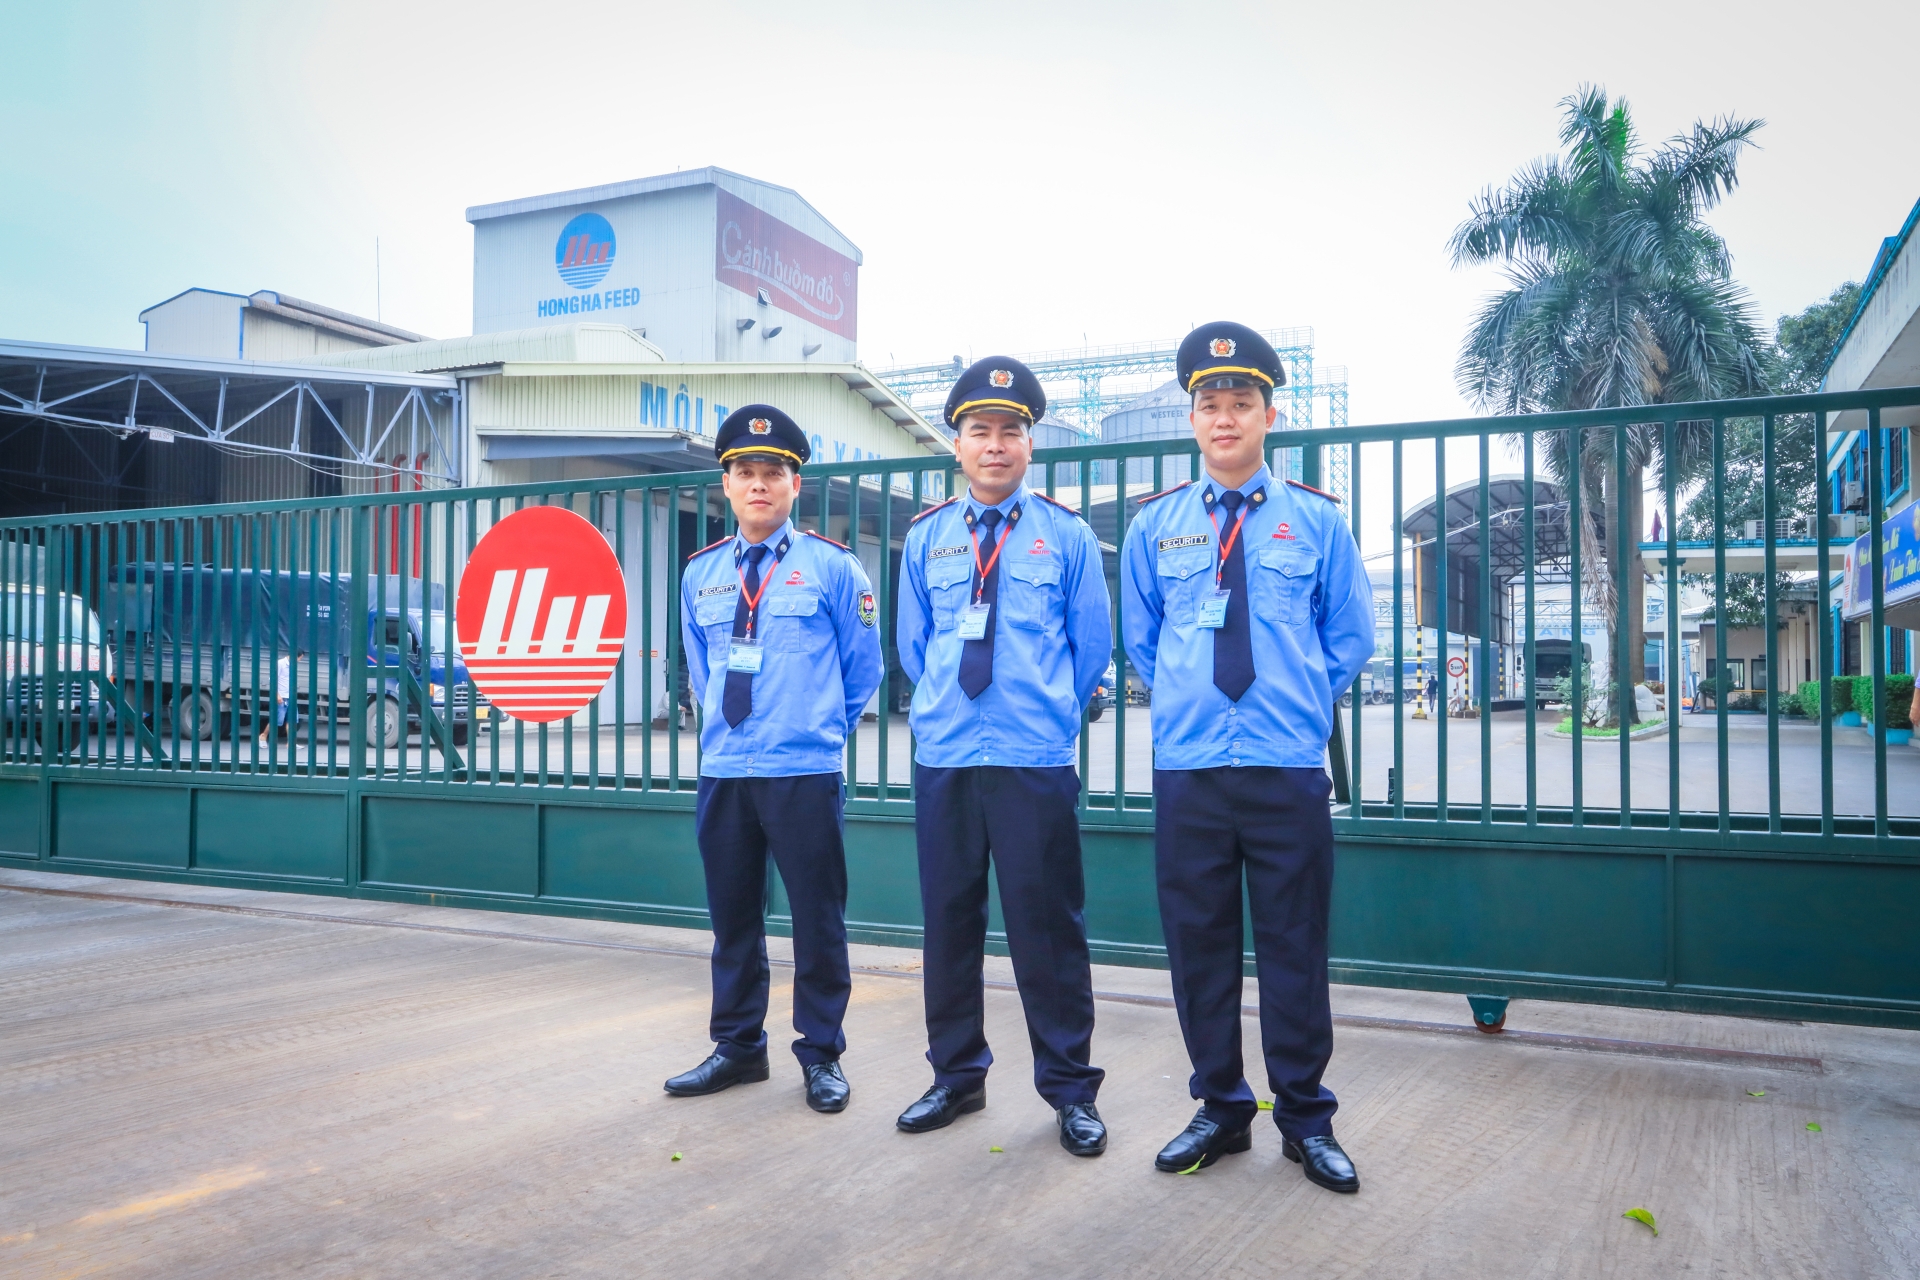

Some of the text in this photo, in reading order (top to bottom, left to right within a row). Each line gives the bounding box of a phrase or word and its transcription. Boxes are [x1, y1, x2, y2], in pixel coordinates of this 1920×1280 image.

[722, 221, 834, 305] Cánh buồm đỏ
[604, 287, 640, 310] FEED
[640, 381, 703, 435] MÔI
[1150, 410, 1185, 419] WESTEEL
[1162, 535, 1205, 549] SECURITY
[701, 584, 736, 596] SECURITY
